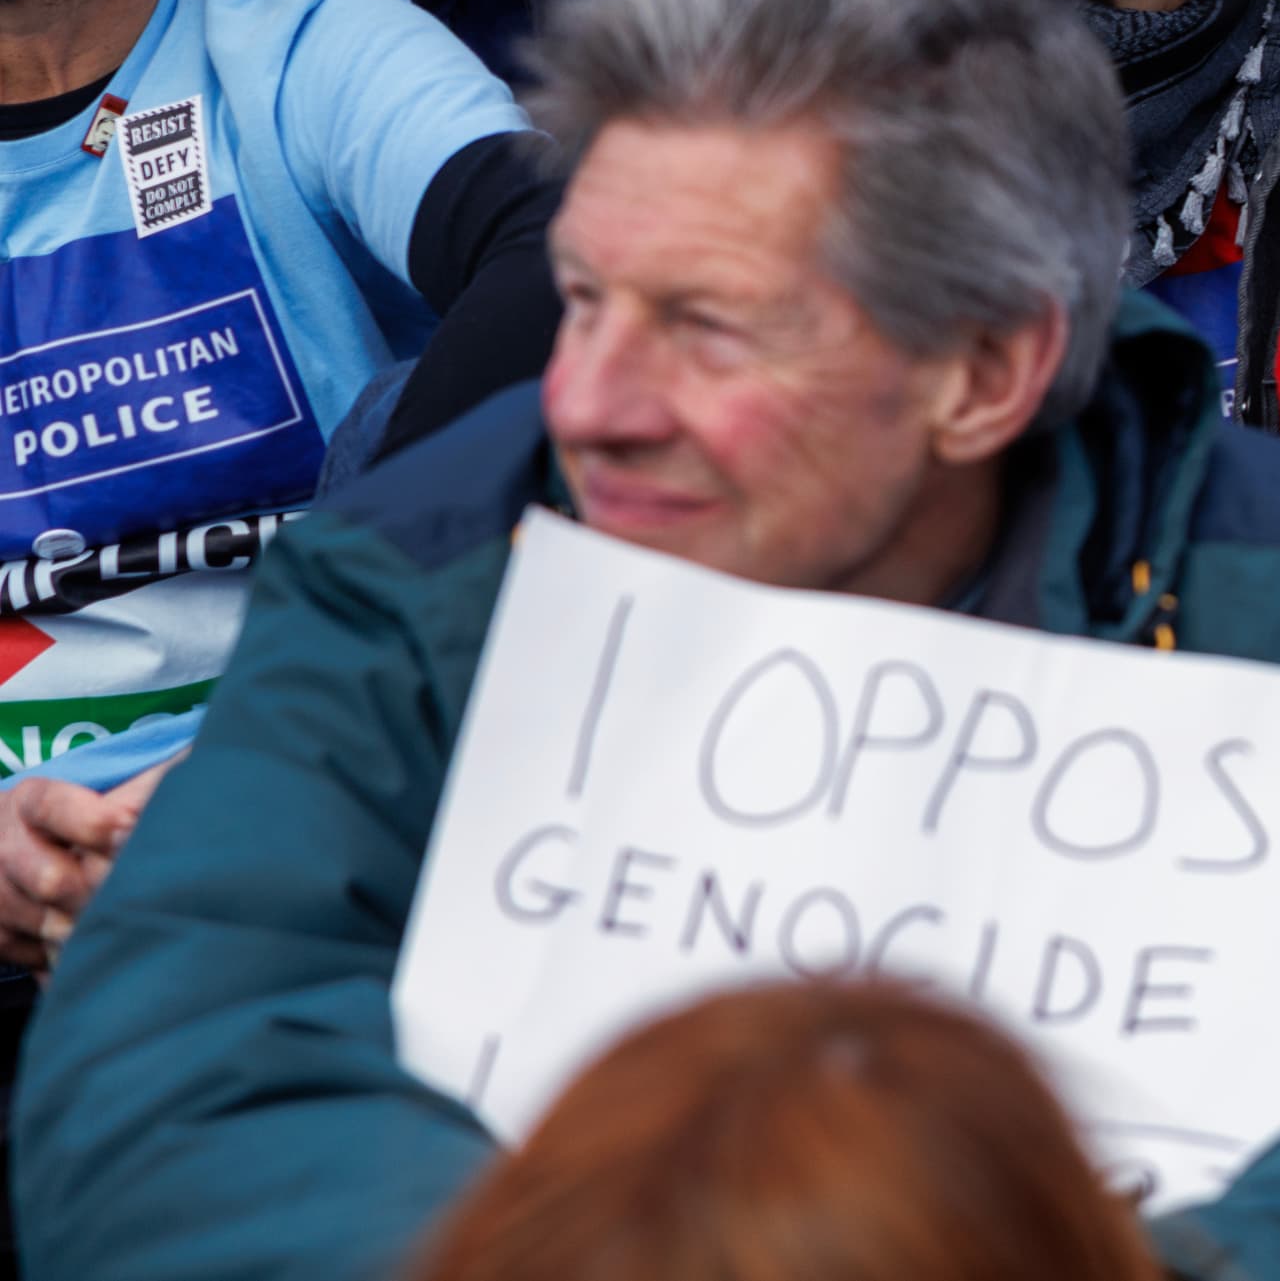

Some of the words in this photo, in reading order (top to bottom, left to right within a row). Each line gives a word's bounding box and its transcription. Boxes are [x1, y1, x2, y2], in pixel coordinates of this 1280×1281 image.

[130, 113, 188, 147] RESIST
[140, 147, 188, 181] DEFY
[145, 187, 166, 205] DO
[168, 176, 195, 196] NOT
[146, 190, 198, 220] COMPLY
[0, 327, 239, 417] ETROPOLITAN
[14, 386, 220, 468] POLICE
[565, 593, 634, 801] I
[491, 825, 1216, 1037] GENOCIDE
